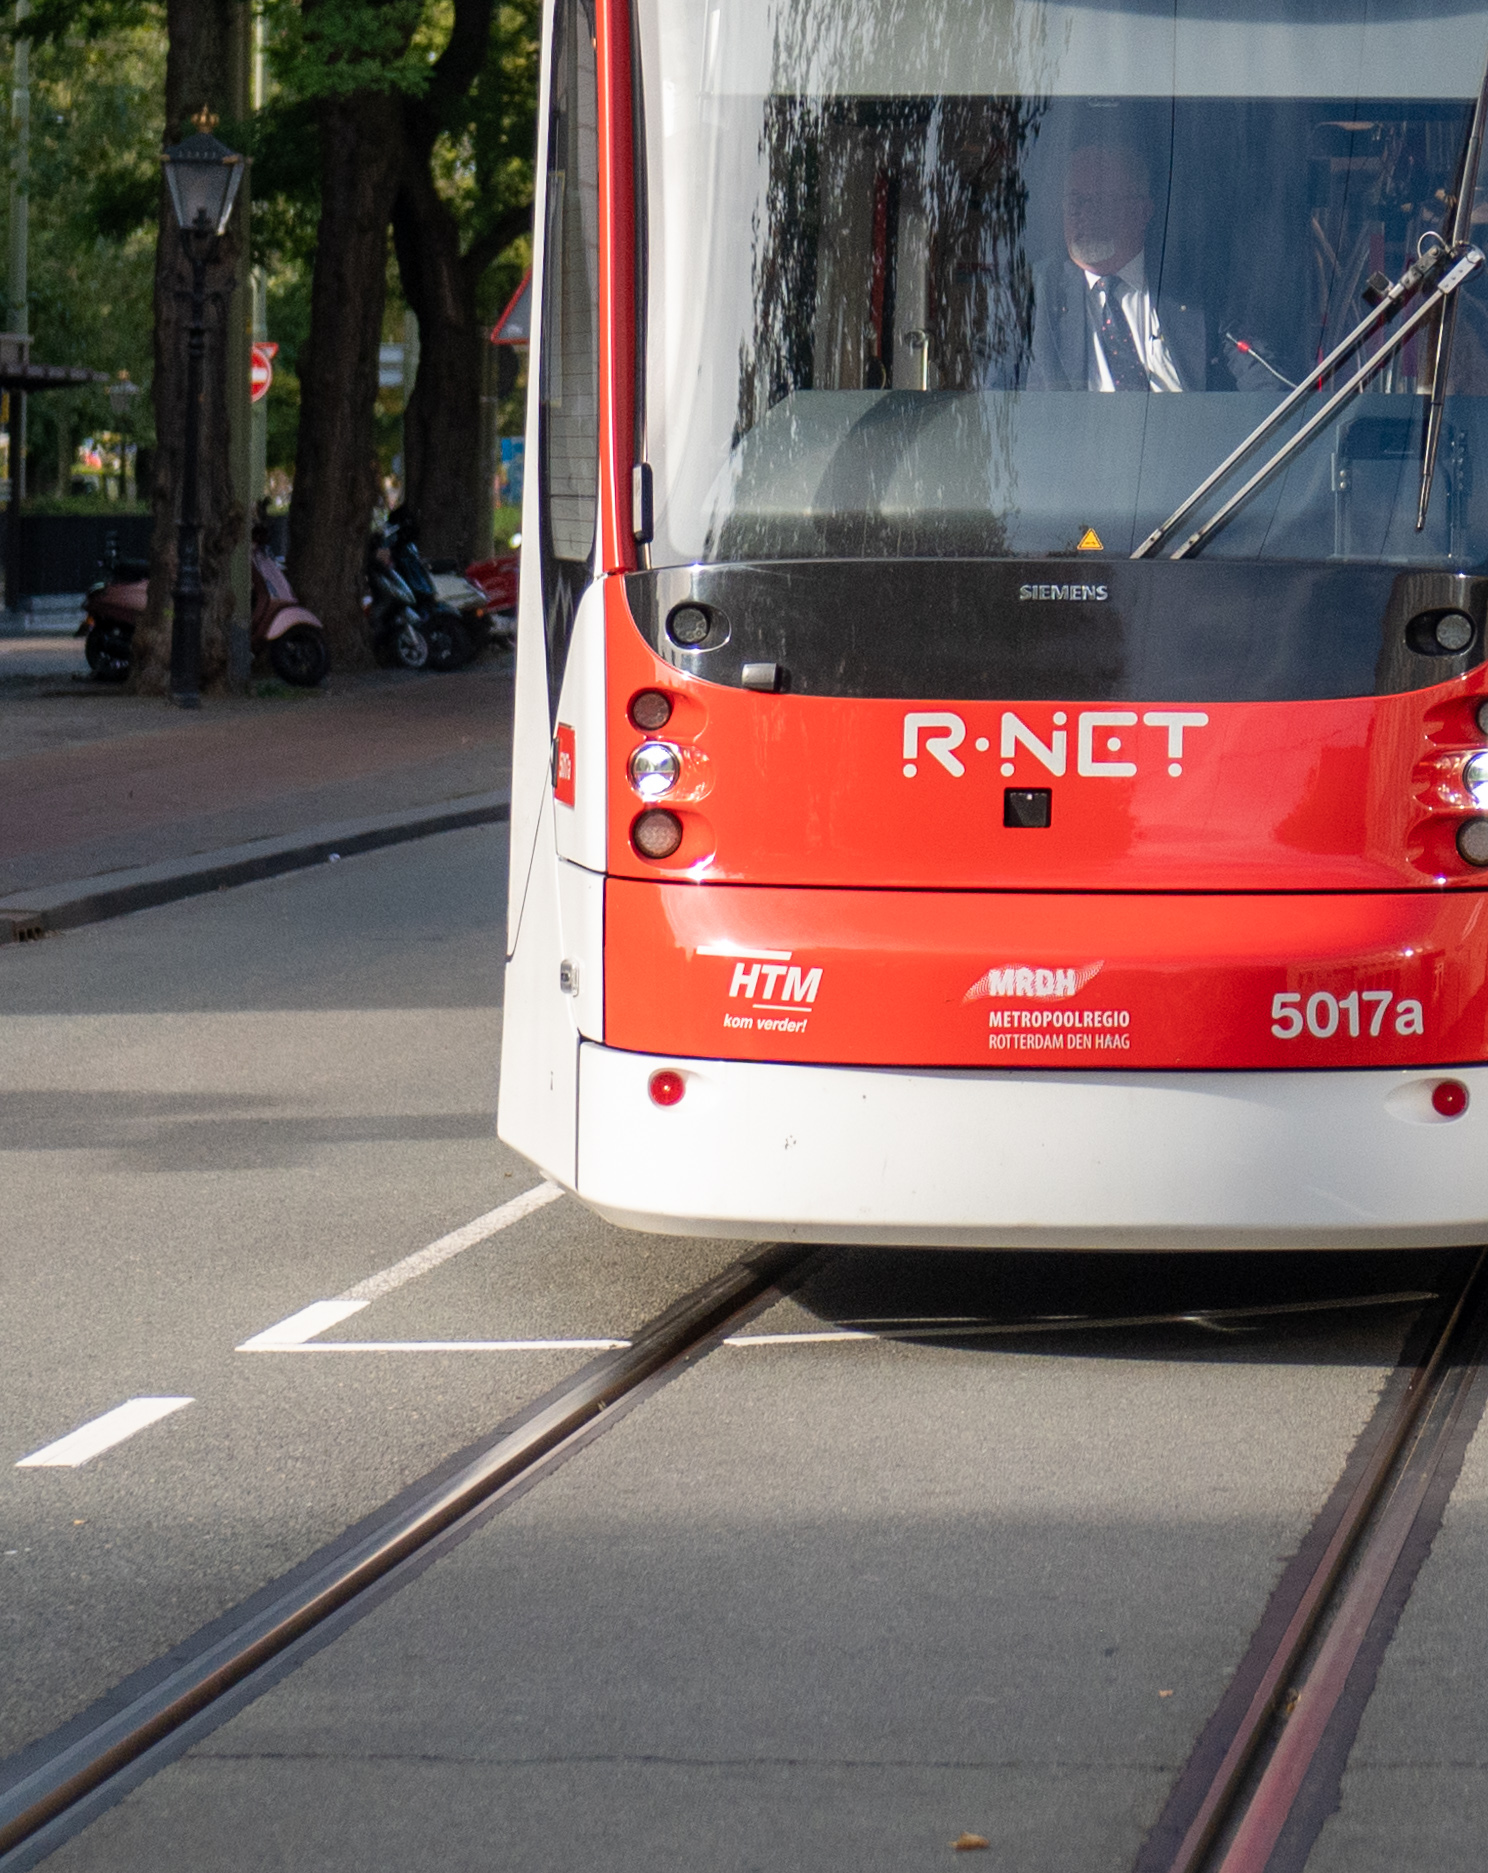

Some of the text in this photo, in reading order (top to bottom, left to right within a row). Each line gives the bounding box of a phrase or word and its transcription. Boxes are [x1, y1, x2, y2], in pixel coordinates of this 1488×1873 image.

[1019, 583, 1109, 602] SIEMENS
[728, 961, 823, 1004] HTM
[988, 967, 1077, 998] MRDH
[723, 1013, 808, 1034] kom verder!
[988, 1010, 1131, 1028] METROPOOLREGIO
[1270, 989, 1425, 1040] 5017a
[988, 1033, 1131, 1050] ROTTERDAM DEN HAAG
